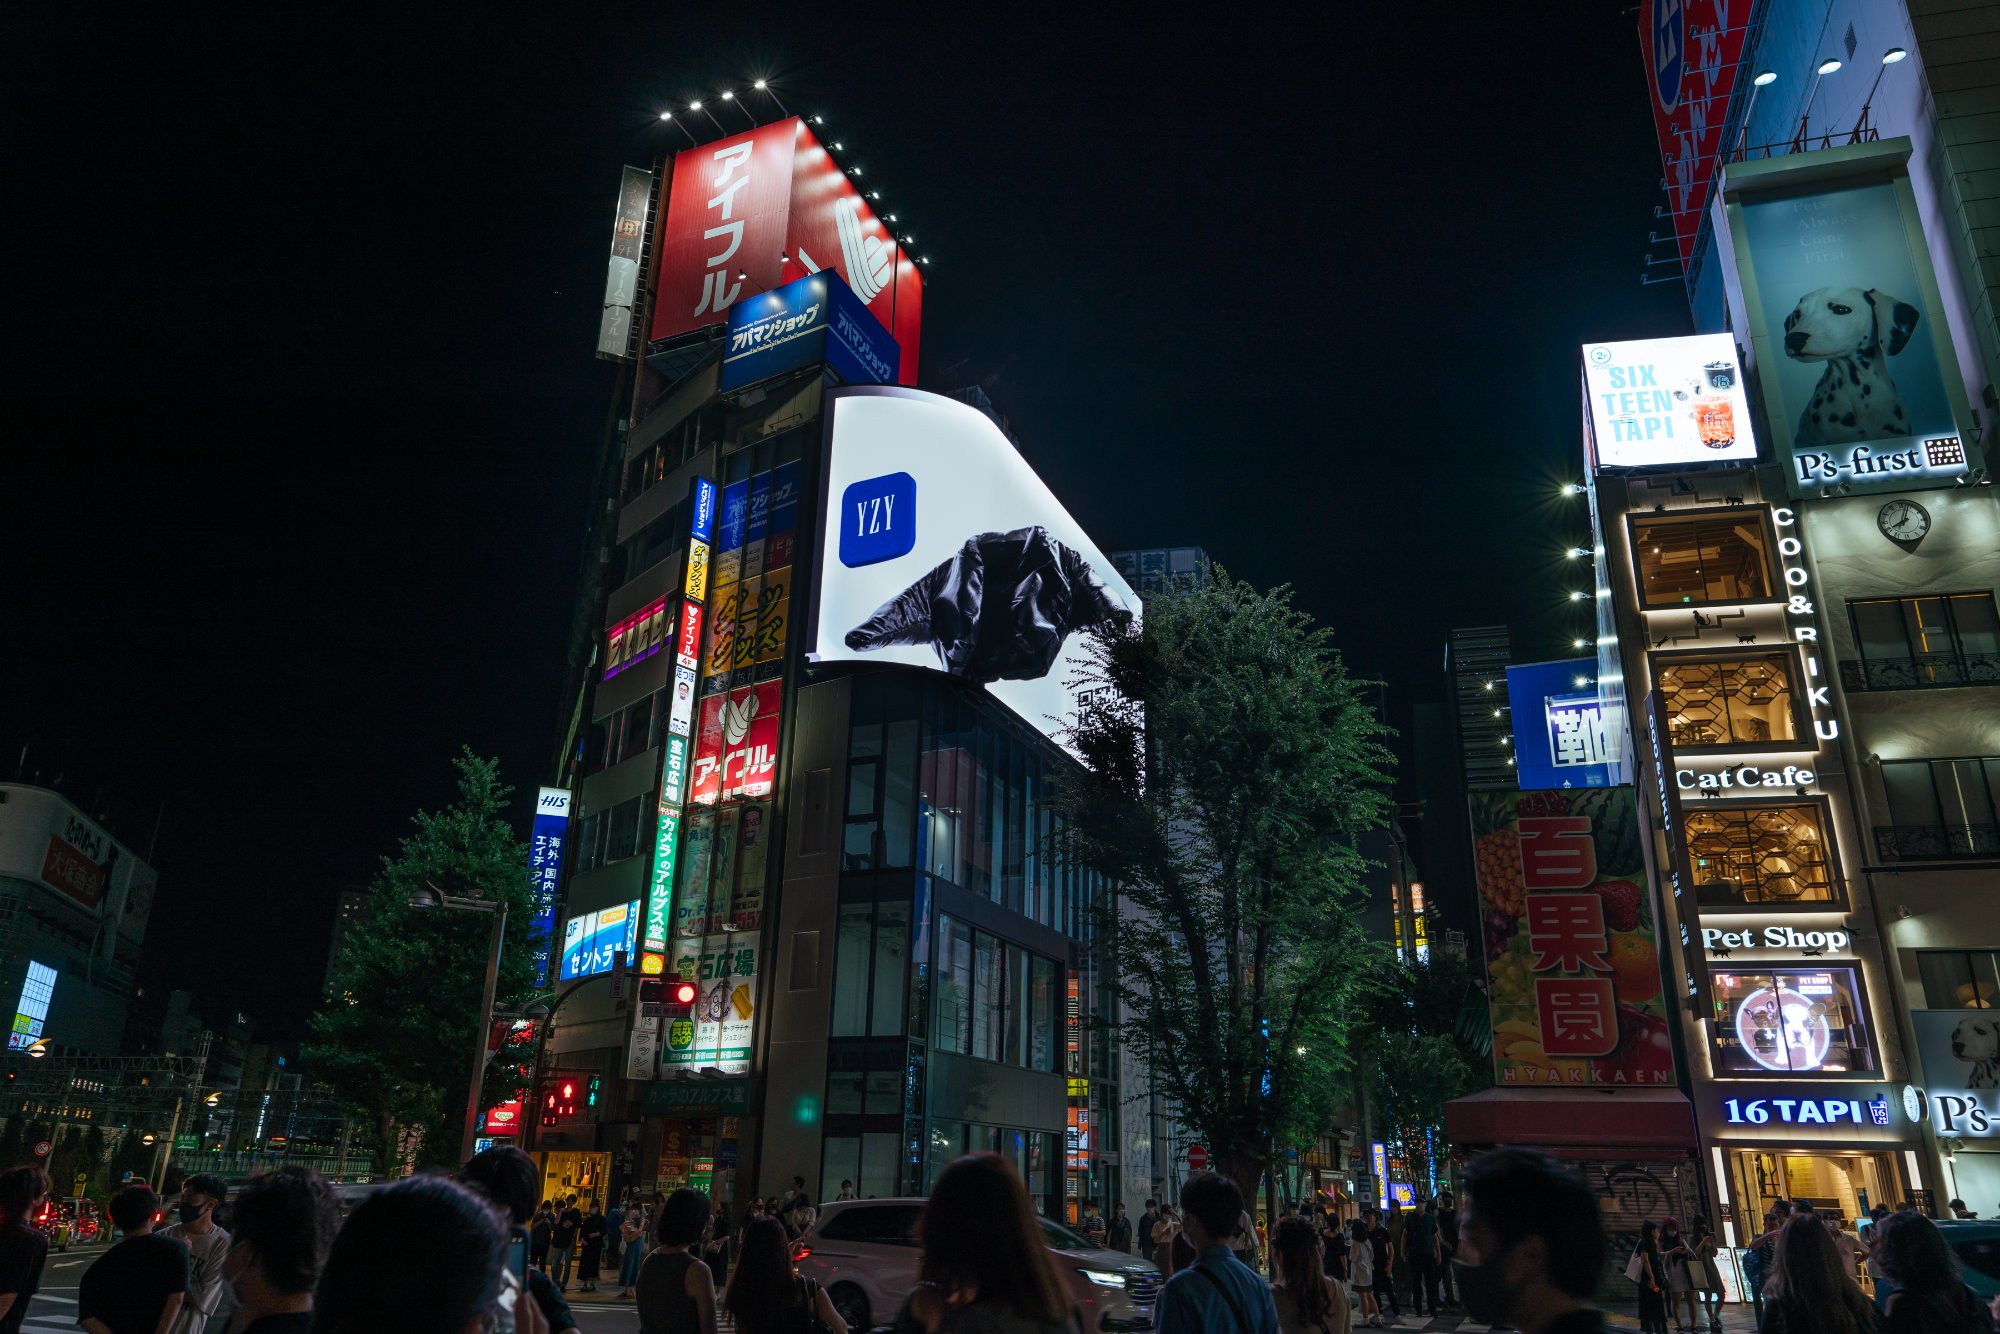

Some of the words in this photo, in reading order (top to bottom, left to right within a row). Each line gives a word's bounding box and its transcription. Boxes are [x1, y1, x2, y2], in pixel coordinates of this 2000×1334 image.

[694, 140, 753, 317] アイフル
[731, 303, 820, 352] アパマンショップ
[837, 311, 892, 380] アパマンショップ
[1609, 364, 1657, 389] SIX
[1601, 389, 1673, 417] TEEN
[1608, 415, 1674, 442] TAPI
[1796, 446, 1922, 481] P's-first
[857, 494, 895, 536] YZY
[684, 616, 697, 656] アイフル
[682, 657, 692, 666] 4F
[665, 740, 684, 801] 宝石広場
[696, 744, 776, 787] アイフル
[1676, 768, 1733, 790] Cat
[1736, 765, 1815, 788] Cafe
[648, 817, 675, 940] カメラのアルプス堂
[567, 921, 578, 938] 3F
[1518, 816, 1620, 1056] 百果園
[1701, 928, 1756, 949] Pet
[1763, 926, 1847, 953] Shop
[677, 949, 755, 981] 宝石広場
[671, 1021, 692, 1036] 買取
[671, 1035, 692, 1046] SHOP
[1503, 1068, 1668, 1083] HYAKKAEN
[1724, 1098, 1769, 1124] 16
[1773, 1100, 1863, 1124] TAPI
[1873, 1108, 1886, 1118] 16
